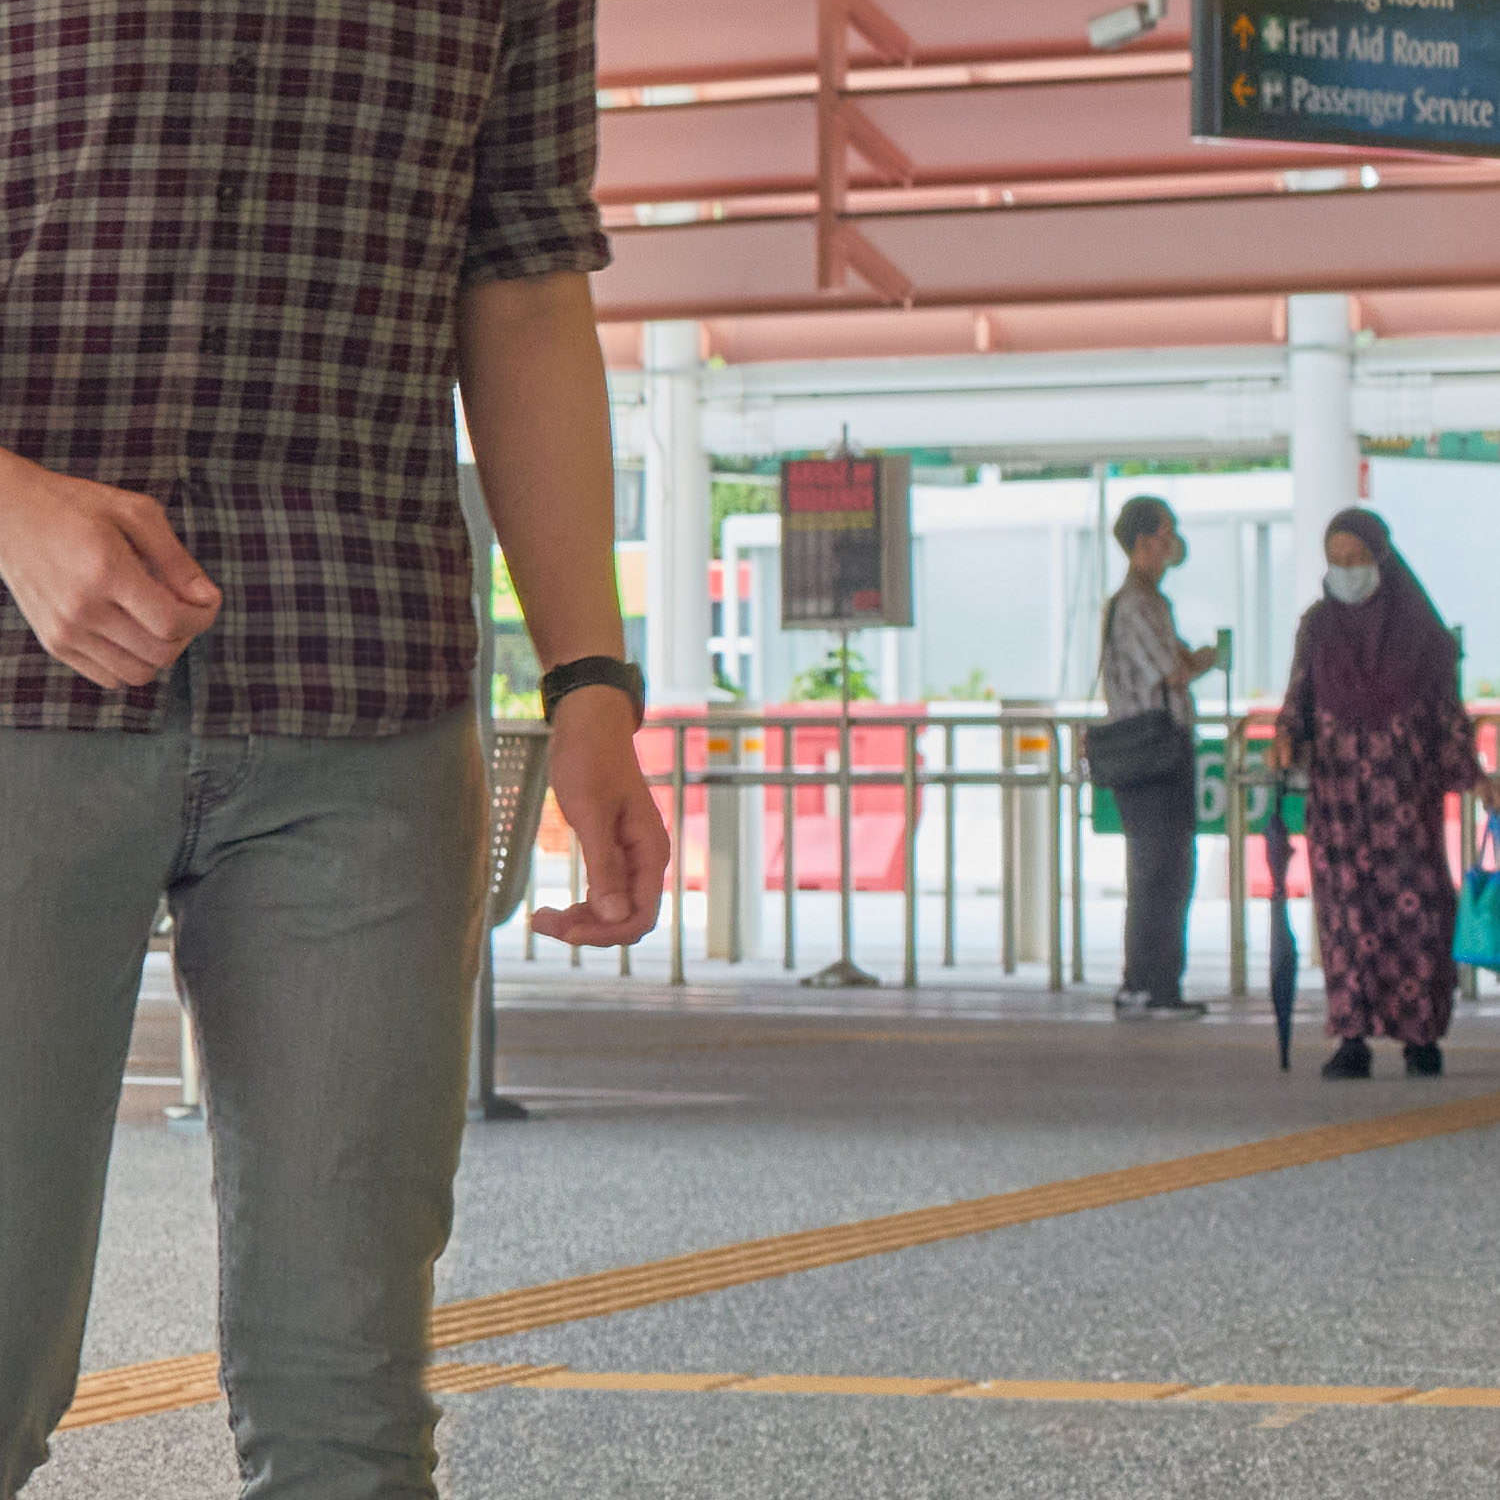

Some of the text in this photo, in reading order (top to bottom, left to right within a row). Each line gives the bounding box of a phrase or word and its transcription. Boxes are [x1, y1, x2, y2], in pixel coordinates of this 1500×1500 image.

[1289, 18, 1459, 68] First Aid Room
[1291, 75, 1495, 128] Passenger Service
